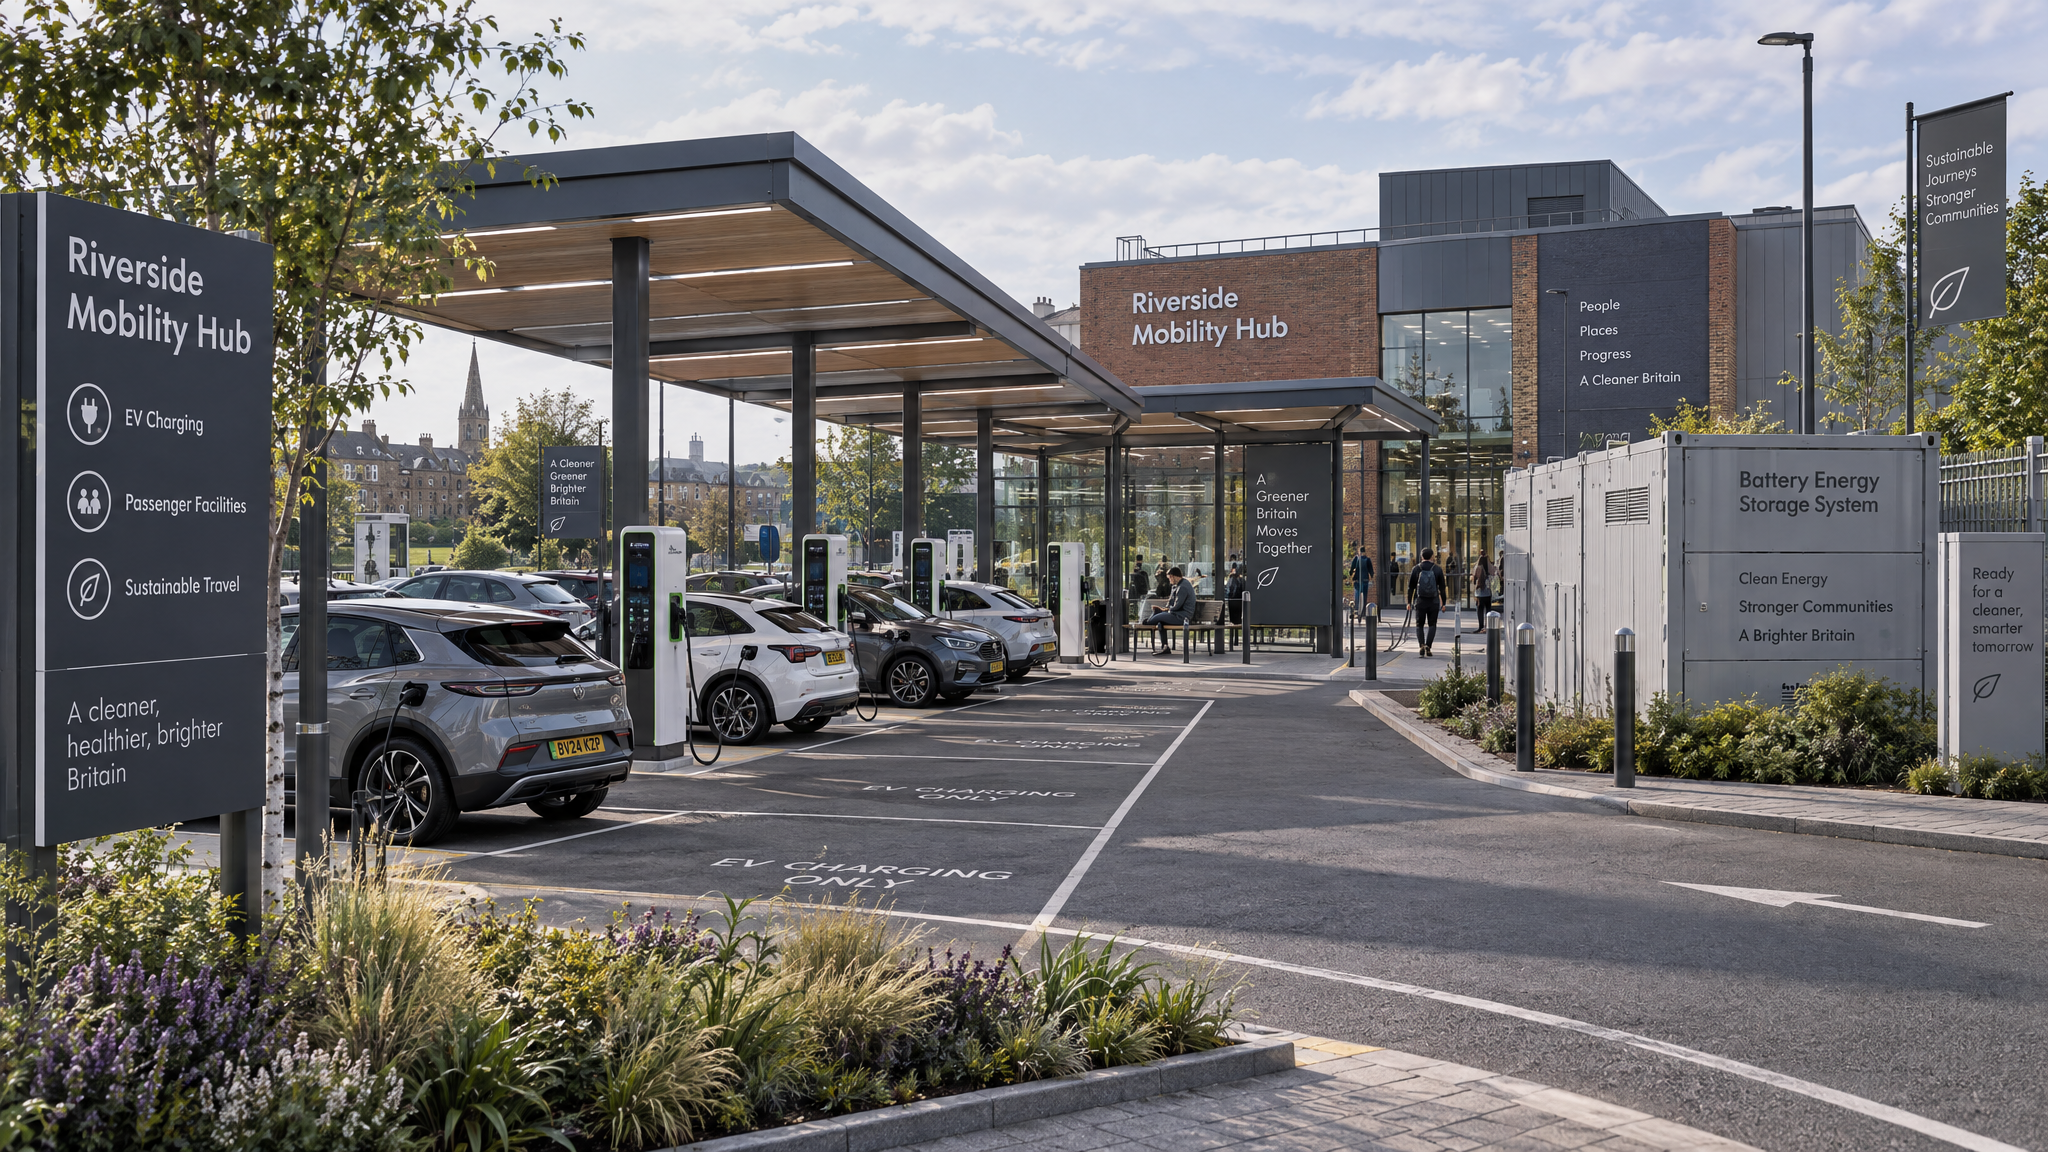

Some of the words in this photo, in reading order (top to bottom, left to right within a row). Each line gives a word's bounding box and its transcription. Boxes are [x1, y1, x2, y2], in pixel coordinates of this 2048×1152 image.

[1926, 141, 1993, 167] Sustainable
[1926, 166, 1977, 187] Journeys
[1926, 188, 1976, 207] Stronger
[1926, 202, 1998, 226] Communities
[68, 236, 203, 296] Riverside
[1133, 286, 1238, 313] Riverside
[1580, 299, 1620, 313] People
[67, 293, 188, 355] Mobility
[198, 315, 251, 354] Hub
[1132, 319, 1228, 347] Mobility
[1236, 315, 1288, 340] Hub
[1580, 325, 1618, 336] Places
[1580, 349, 1631, 363] Progress
[1580, 375, 1589, 386] A
[1593, 373, 1638, 385] Cleaner
[1643, 371, 1681, 384] Britain
[125, 409, 142, 427] EV
[146, 410, 203, 436] Charging
[550, 459, 557, 468] A
[560, 458, 594, 468] Cleaner
[550, 471, 587, 480] Greener
[1256, 473, 1266, 485] A
[1740, 471, 1808, 493] Battery
[1815, 471, 1879, 493] Energy
[550, 484, 586, 495] Brighter
[1256, 490, 1309, 502] Greener
[125, 494, 191, 516] Passenger
[195, 496, 246, 514] Facilities
[550, 496, 579, 505] Britain
[1740, 495, 1809, 517] Storage
[1815, 495, 1878, 517] System
[1256, 508, 1297, 519] Britain
[1256, 525, 1298, 537] Moves
[1256, 541, 1312, 558] Together
[1739, 572, 1777, 585] Clean
[1782, 572, 1828, 588] Energy
[1973, 566, 2014, 583] Ready
[125, 577, 199, 596] Sustainable
[204, 576, 240, 594] Travel
[1973, 584, 1990, 598] for
[1994, 588, 2003, 598] a
[1739, 600, 1798, 616] Stronger
[1803, 600, 1893, 613] Communities
[1973, 603, 2023, 617] cleaner,
[1973, 623, 2022, 634] smarter
[1739, 630, 1749, 642] A
[1754, 629, 1807, 645] Brighter
[1812, 629, 1855, 642] Britain
[1973, 642, 2034, 653] tomorrow
[68, 701, 82, 725] A
[89, 697, 160, 723] cleaner,
[68, 729, 151, 758] healthier,
[157, 719, 223, 747] brighter
[557, 739, 582, 756] BV24
[583, 737, 601, 752] KZP
[68, 763, 126, 791] Britain
[915, 787, 1076, 798] CHARGING
[918, 794, 1010, 802] ONLY
[710, 858, 775, 868] EV
[784, 861, 1013, 880] CHARGING
[784, 875, 915, 889] ONLY
